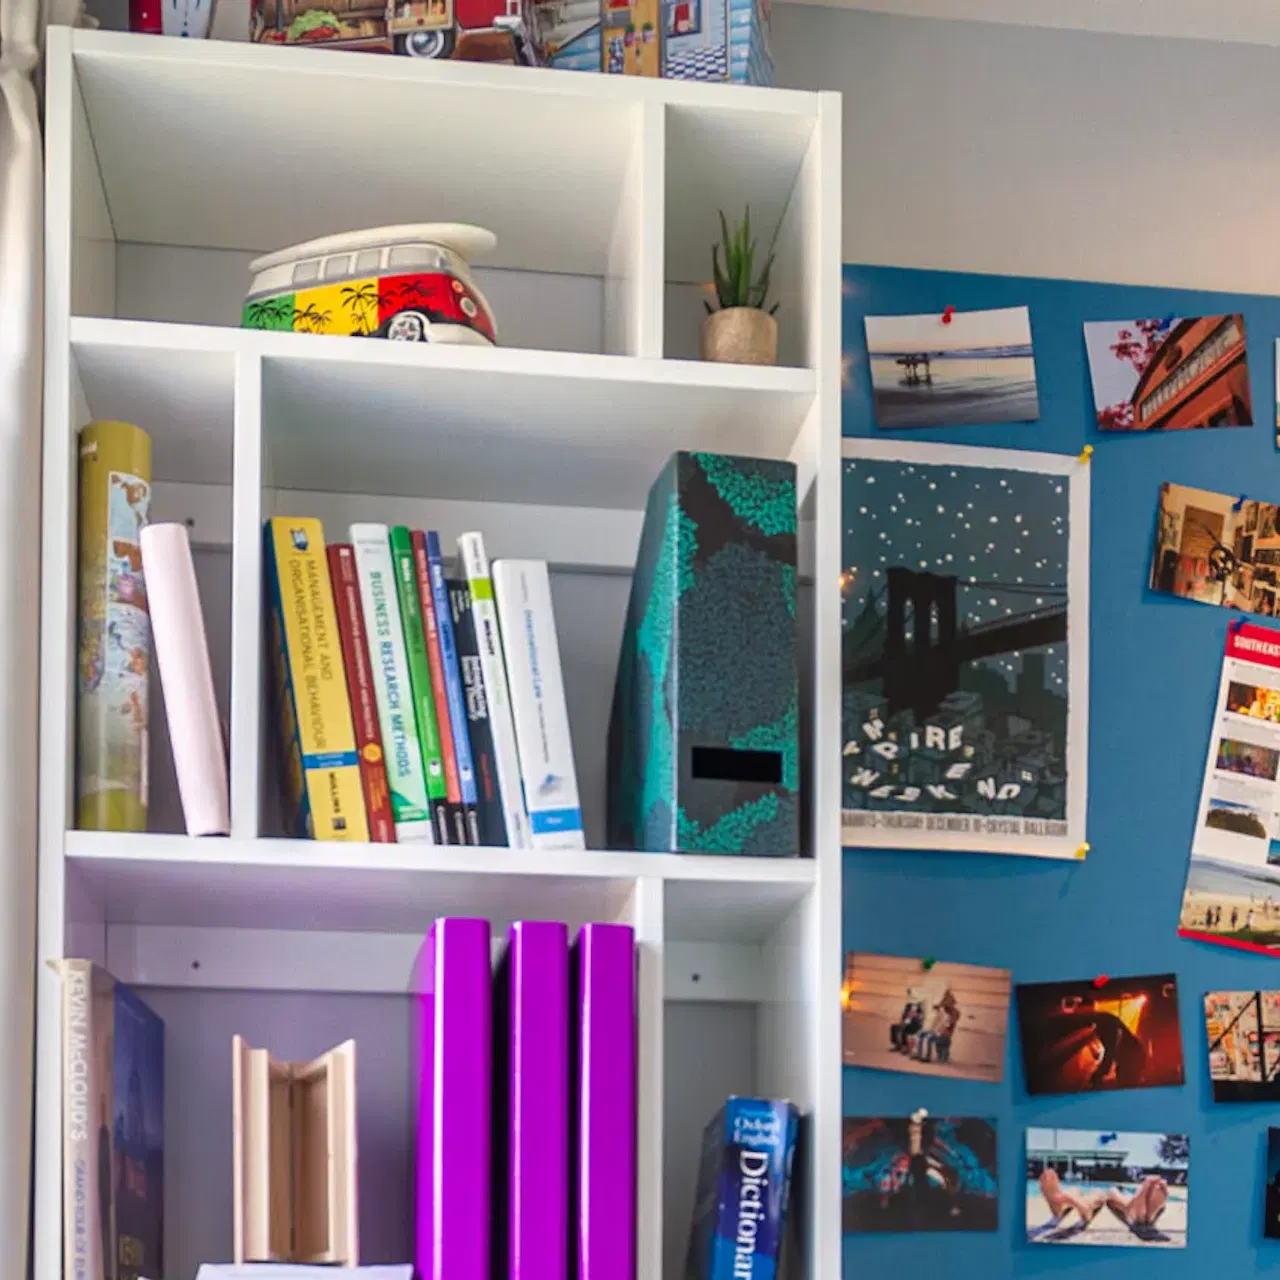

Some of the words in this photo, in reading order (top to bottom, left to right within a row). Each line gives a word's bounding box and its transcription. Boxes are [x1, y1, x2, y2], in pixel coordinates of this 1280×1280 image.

[306, 559, 329, 649] MANAGEMENT
[320, 653, 333, 681] AND
[370, 571, 391, 637] BUSINESS
[289, 559, 314, 671] ORGANISATIONAL
[305, 675, 327, 749] BEHAVIOUR
[380, 641, 401, 709] RESEARCH
[391, 713, 412, 778] METHODS
[69, 970, 88, 1027] KEVIN
